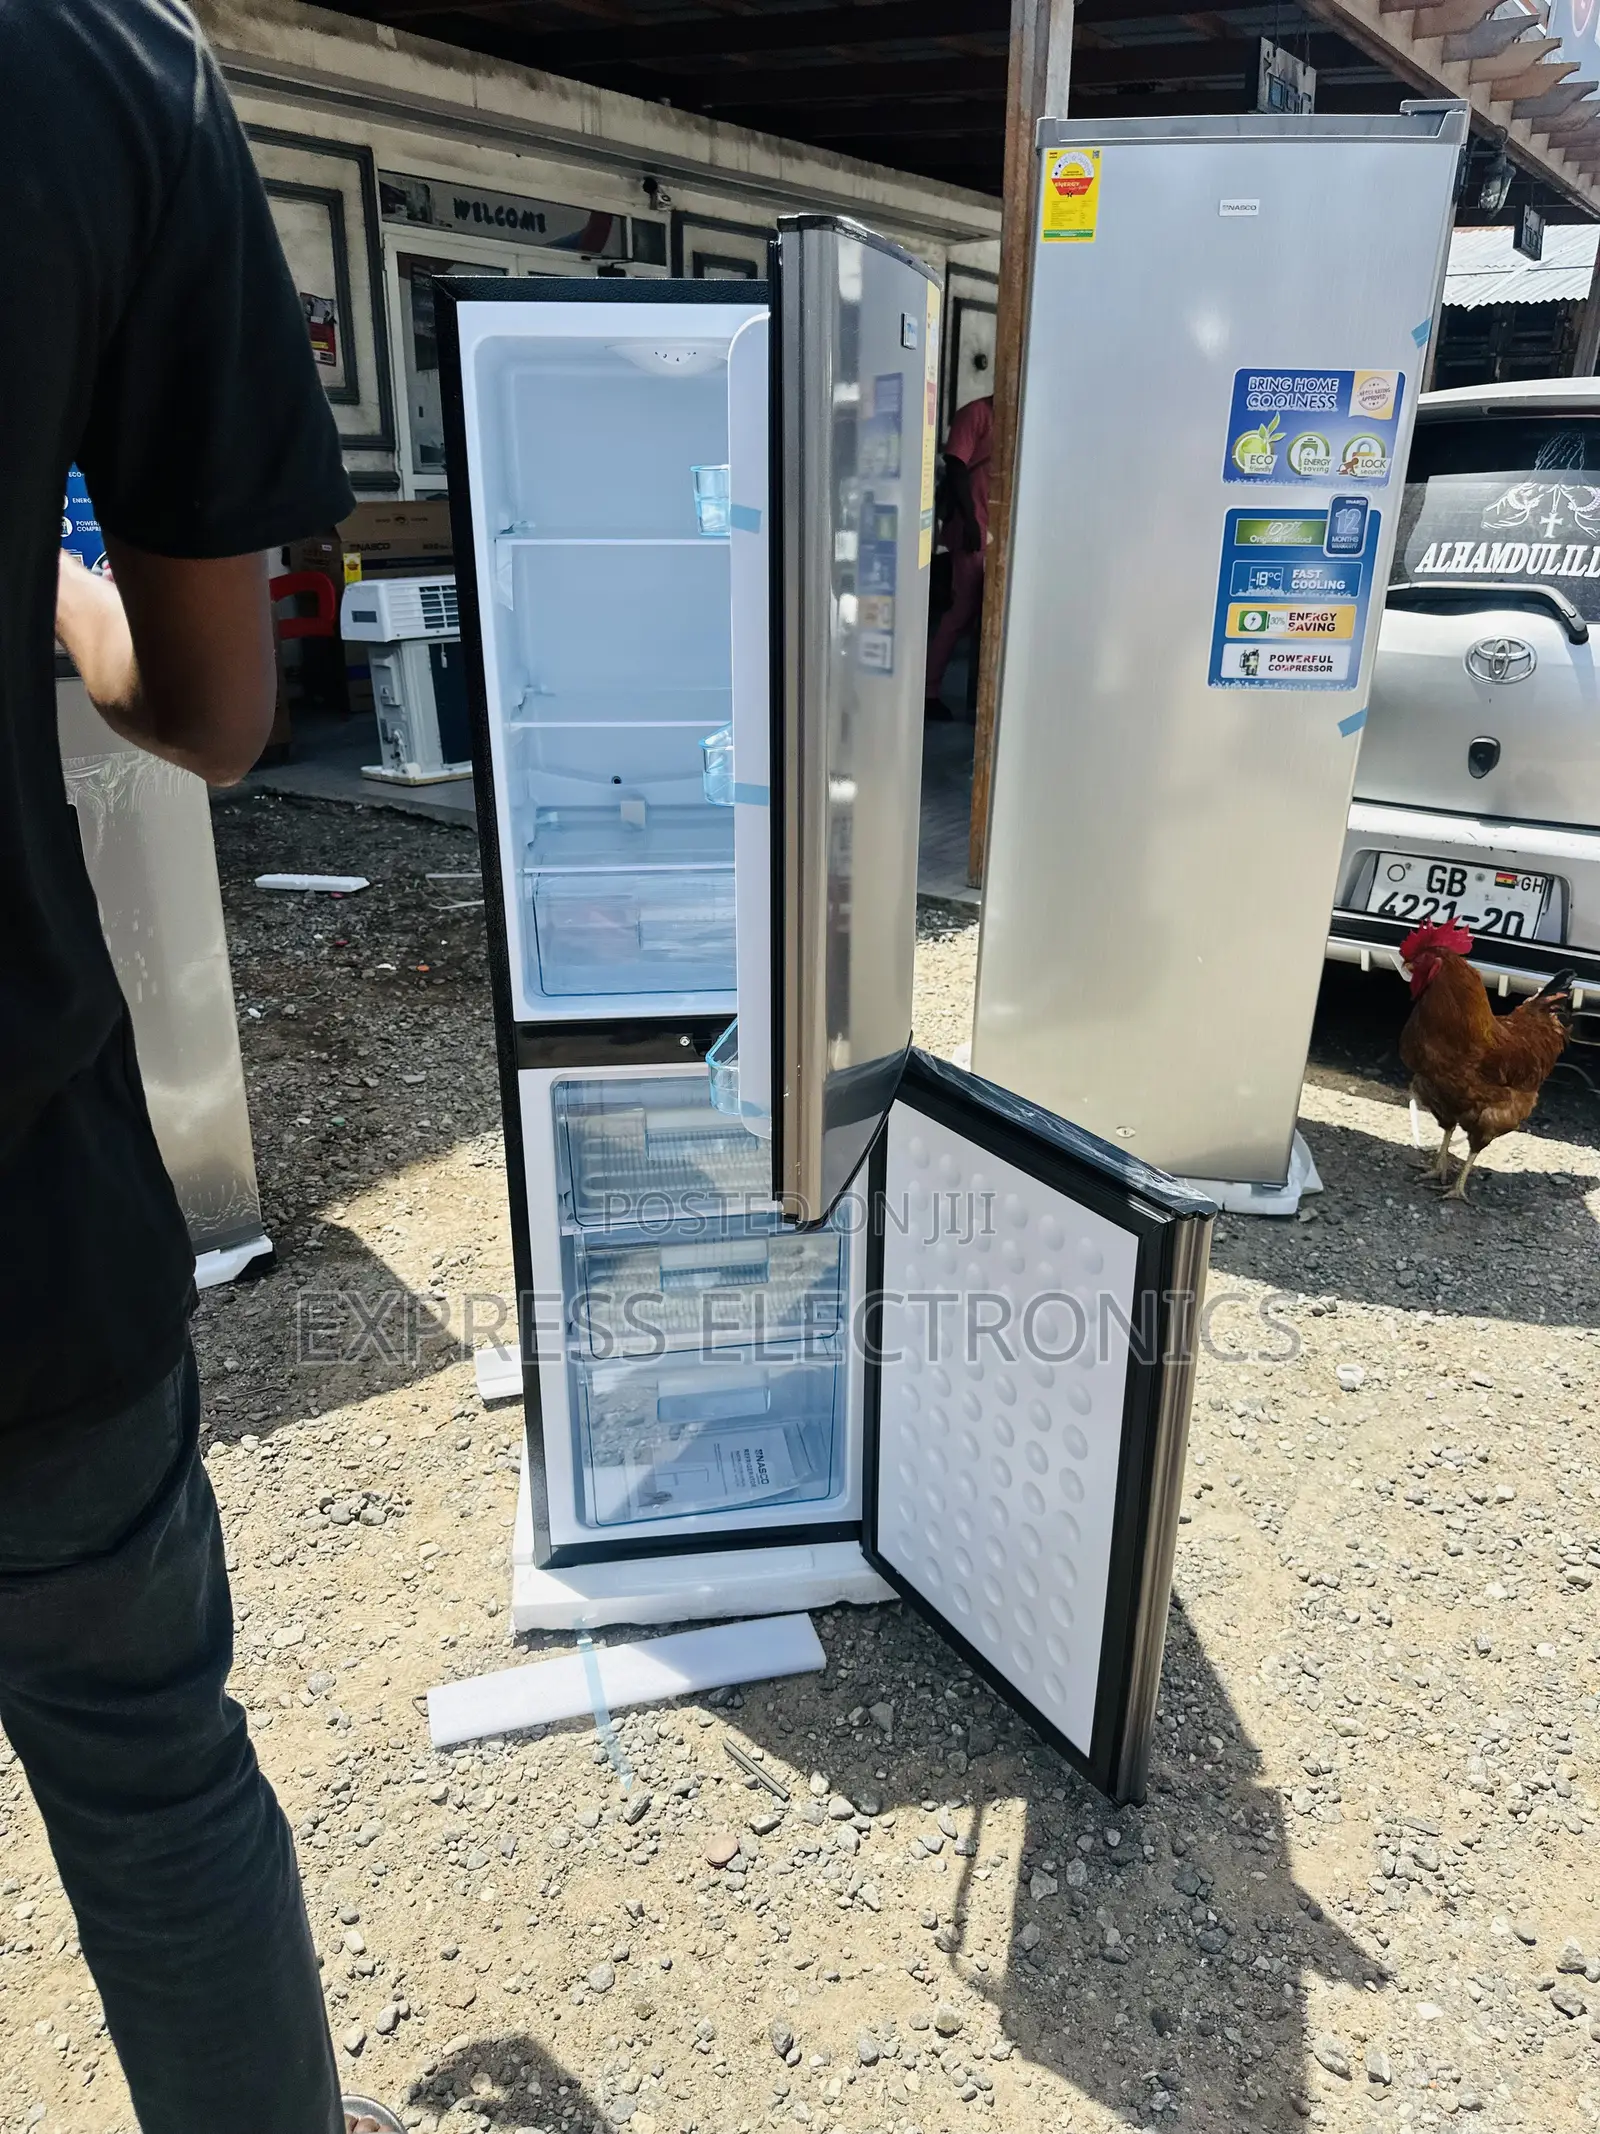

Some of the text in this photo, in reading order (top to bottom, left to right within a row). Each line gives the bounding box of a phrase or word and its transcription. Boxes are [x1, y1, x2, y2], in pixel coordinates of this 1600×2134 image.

[453, 198, 546, 234] WELCOME
[1248, 376, 1293, 392] BRING
[1294, 377, 1340, 393] HOME
[1247, 393, 1338, 410] COOLNESS
[1250, 455, 1274, 465] ECO
[1303, 458, 1332, 466] ENERGY
[1361, 459, 1387, 468] LOCK
[1250, 465, 1272, 474] friendly
[1303, 466, 1330, 475] saving
[1360, 468, 1386, 477] security
[1335, 508, 1361, 534] 12
[1250, 535, 1313, 545] Original Product
[1292, 569, 1323, 579] FAST
[1291, 579, 1346, 590] COOLING
[1289, 612, 1337, 622] ENERGY
[1288, 622, 1336, 632] SAVING
[1269, 654, 1334, 664] POWERFUL
[1268, 664, 1333, 672] COMPRESSOR
[1426, 864, 1545, 897] GB GH
